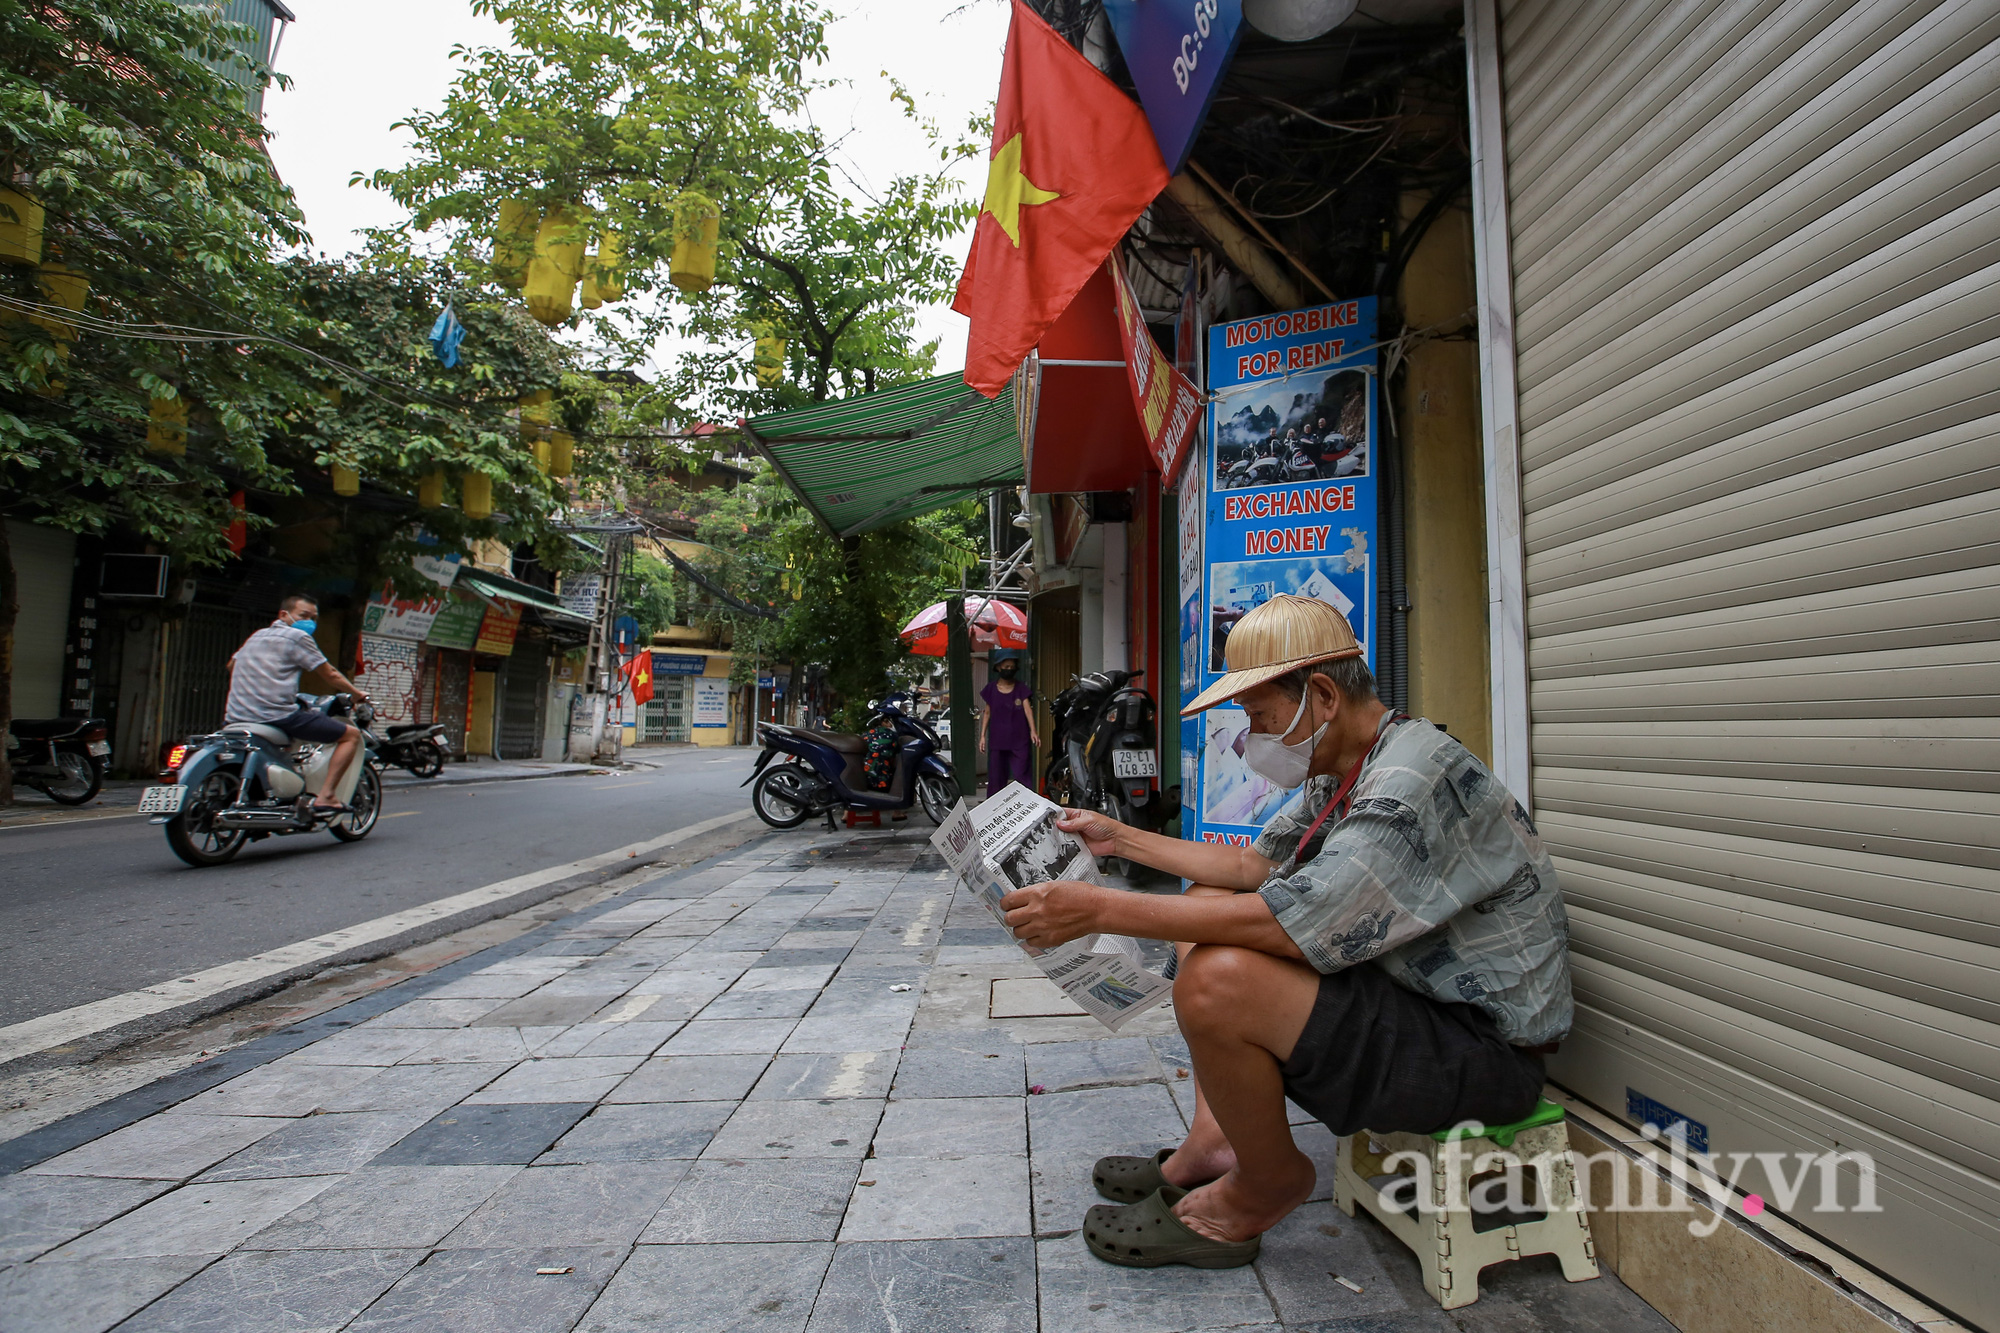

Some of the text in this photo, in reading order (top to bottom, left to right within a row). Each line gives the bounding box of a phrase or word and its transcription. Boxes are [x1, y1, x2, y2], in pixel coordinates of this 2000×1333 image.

[1226, 301, 1358, 348] MOTORBIKE
[1238, 340, 1345, 379] FOR RENT
[1225, 485, 1355, 521] EXCHANGE
[1246, 525, 1331, 555] MONEY
[1118, 763, 1155, 776] 148.39
[985, 822, 996, 832] tra
[992, 819, 1017, 840] Covid-19
